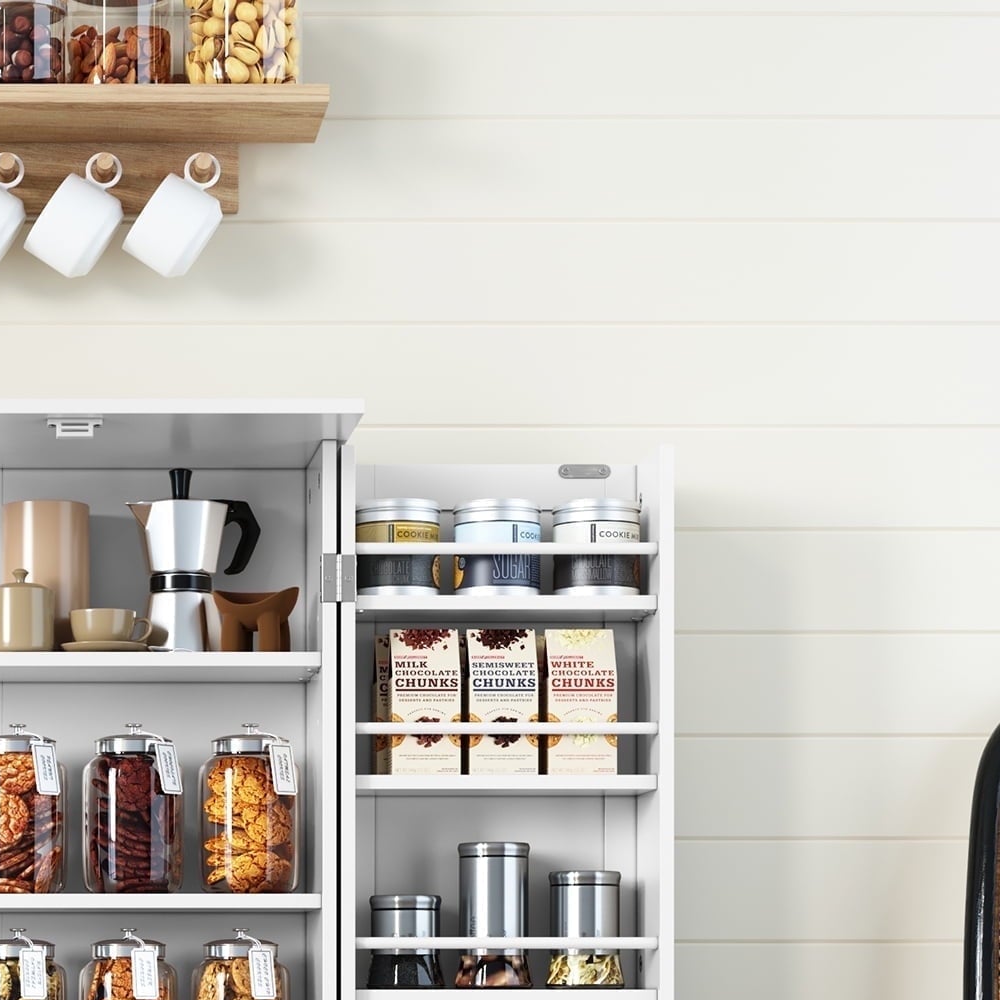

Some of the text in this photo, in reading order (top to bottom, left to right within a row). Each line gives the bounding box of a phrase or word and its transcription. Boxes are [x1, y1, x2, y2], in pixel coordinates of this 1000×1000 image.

[599, 531, 629, 539] COOKIE
[492, 554, 530, 579] SUGAR
[395, 678, 458, 687] CHUNKS
[473, 678, 536, 687] CHUNKS
[552, 678, 615, 687] CHUNKS
